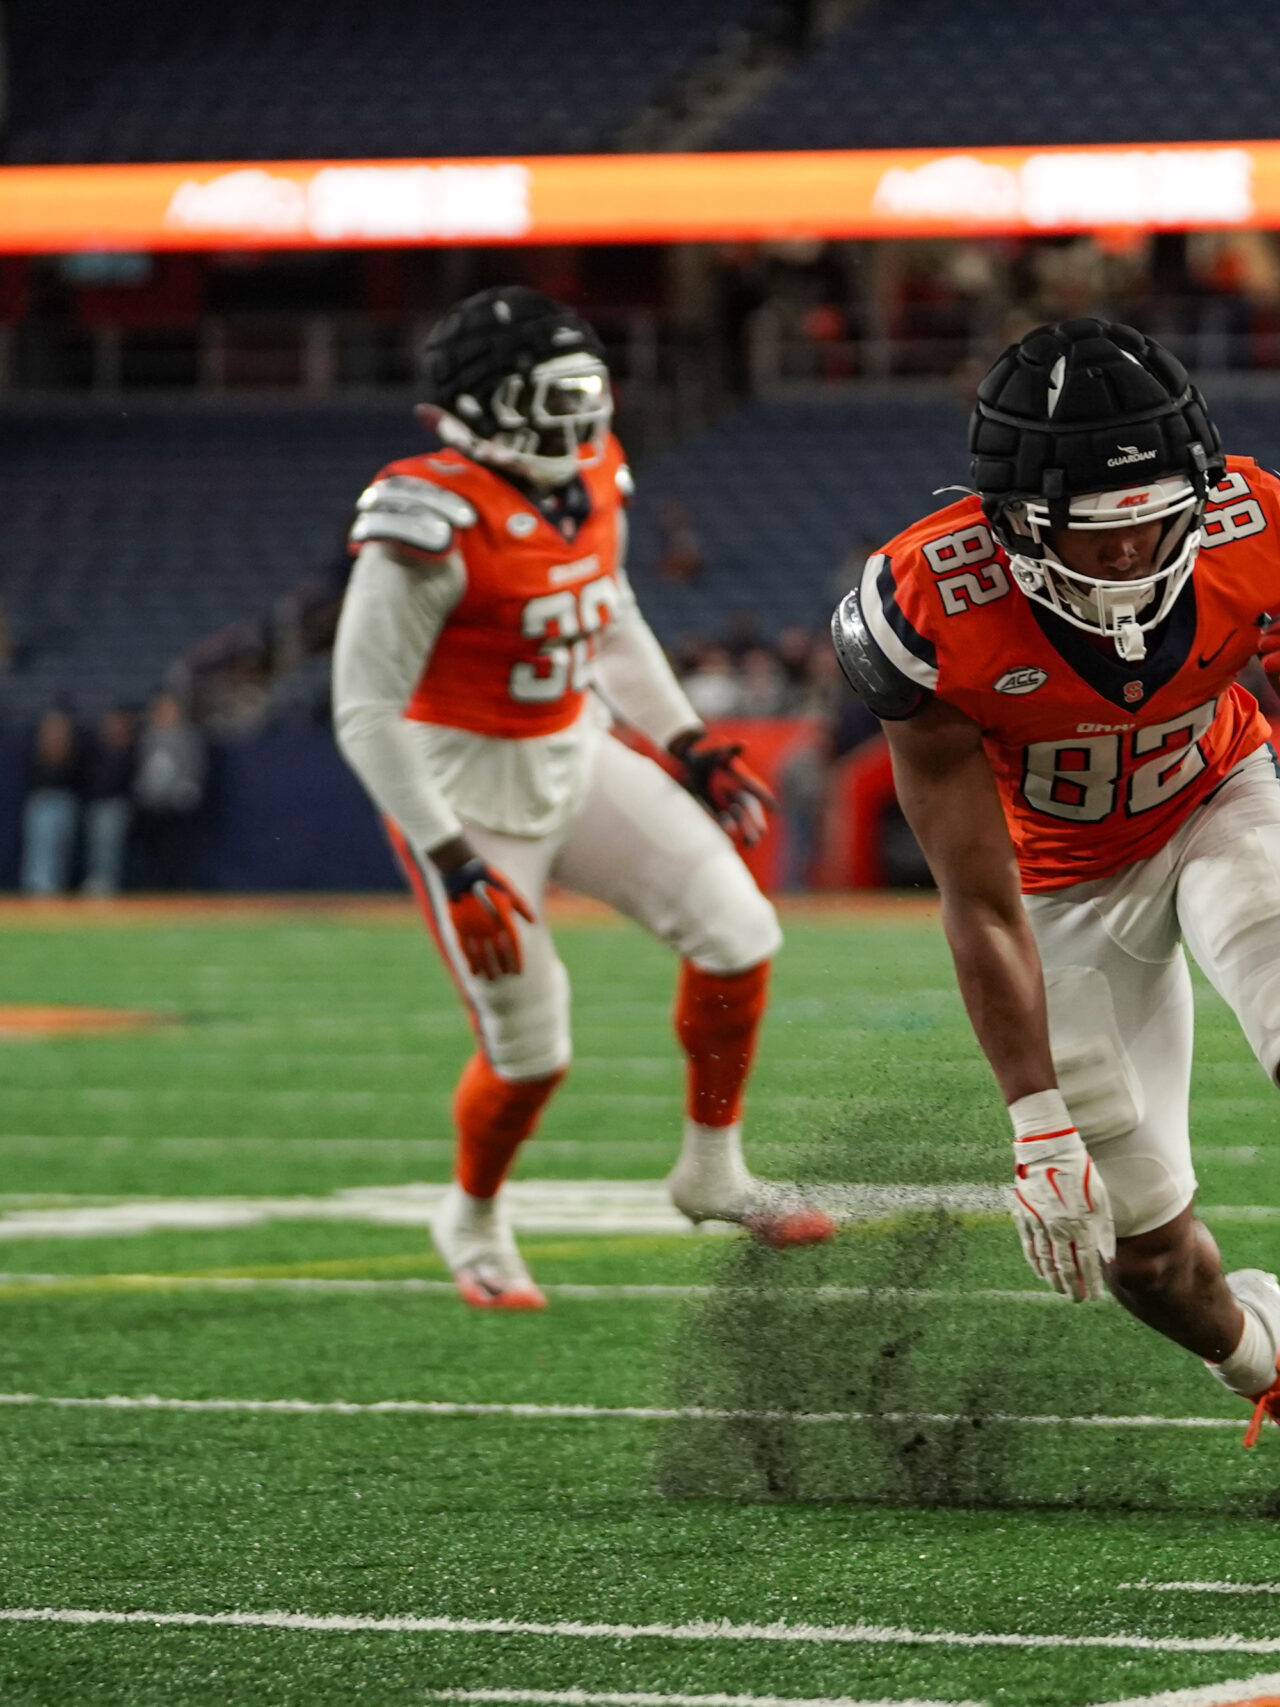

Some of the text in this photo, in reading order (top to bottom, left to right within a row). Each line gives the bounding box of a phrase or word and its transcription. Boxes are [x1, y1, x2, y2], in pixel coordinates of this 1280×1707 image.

[1107, 449, 1157, 467] GUARDIAN
[1117, 492, 1150, 508] ACC
[921, 524, 1011, 618] 82
[1001, 670, 1040, 689] ACC
[1123, 680, 1144, 703] S
[1020, 698, 1219, 825] 82
